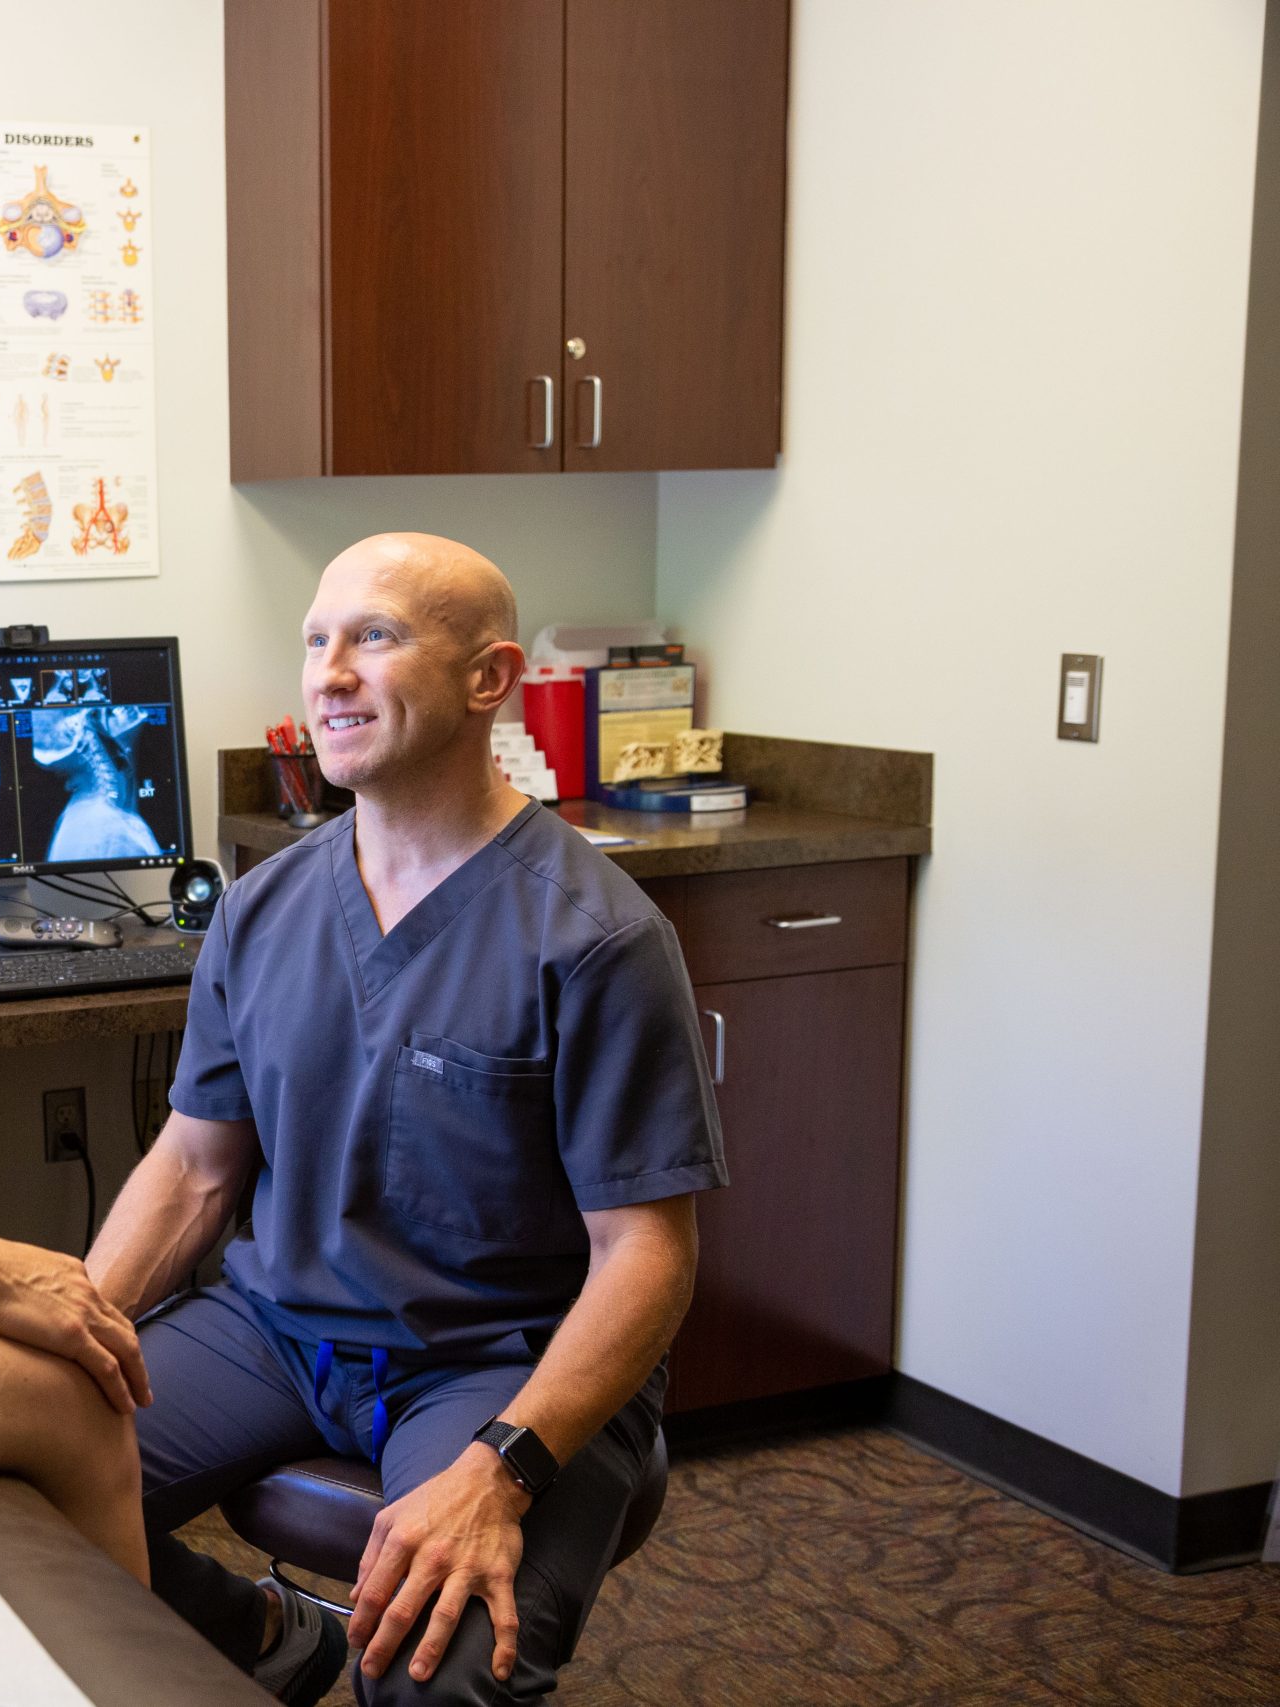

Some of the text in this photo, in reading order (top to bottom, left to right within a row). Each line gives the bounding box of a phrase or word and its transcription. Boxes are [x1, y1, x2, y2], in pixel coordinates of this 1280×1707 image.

[4, 133, 95, 148] DISORDERS
[138, 788, 155, 797] EXT
[13, 865, 36, 874] DELL
